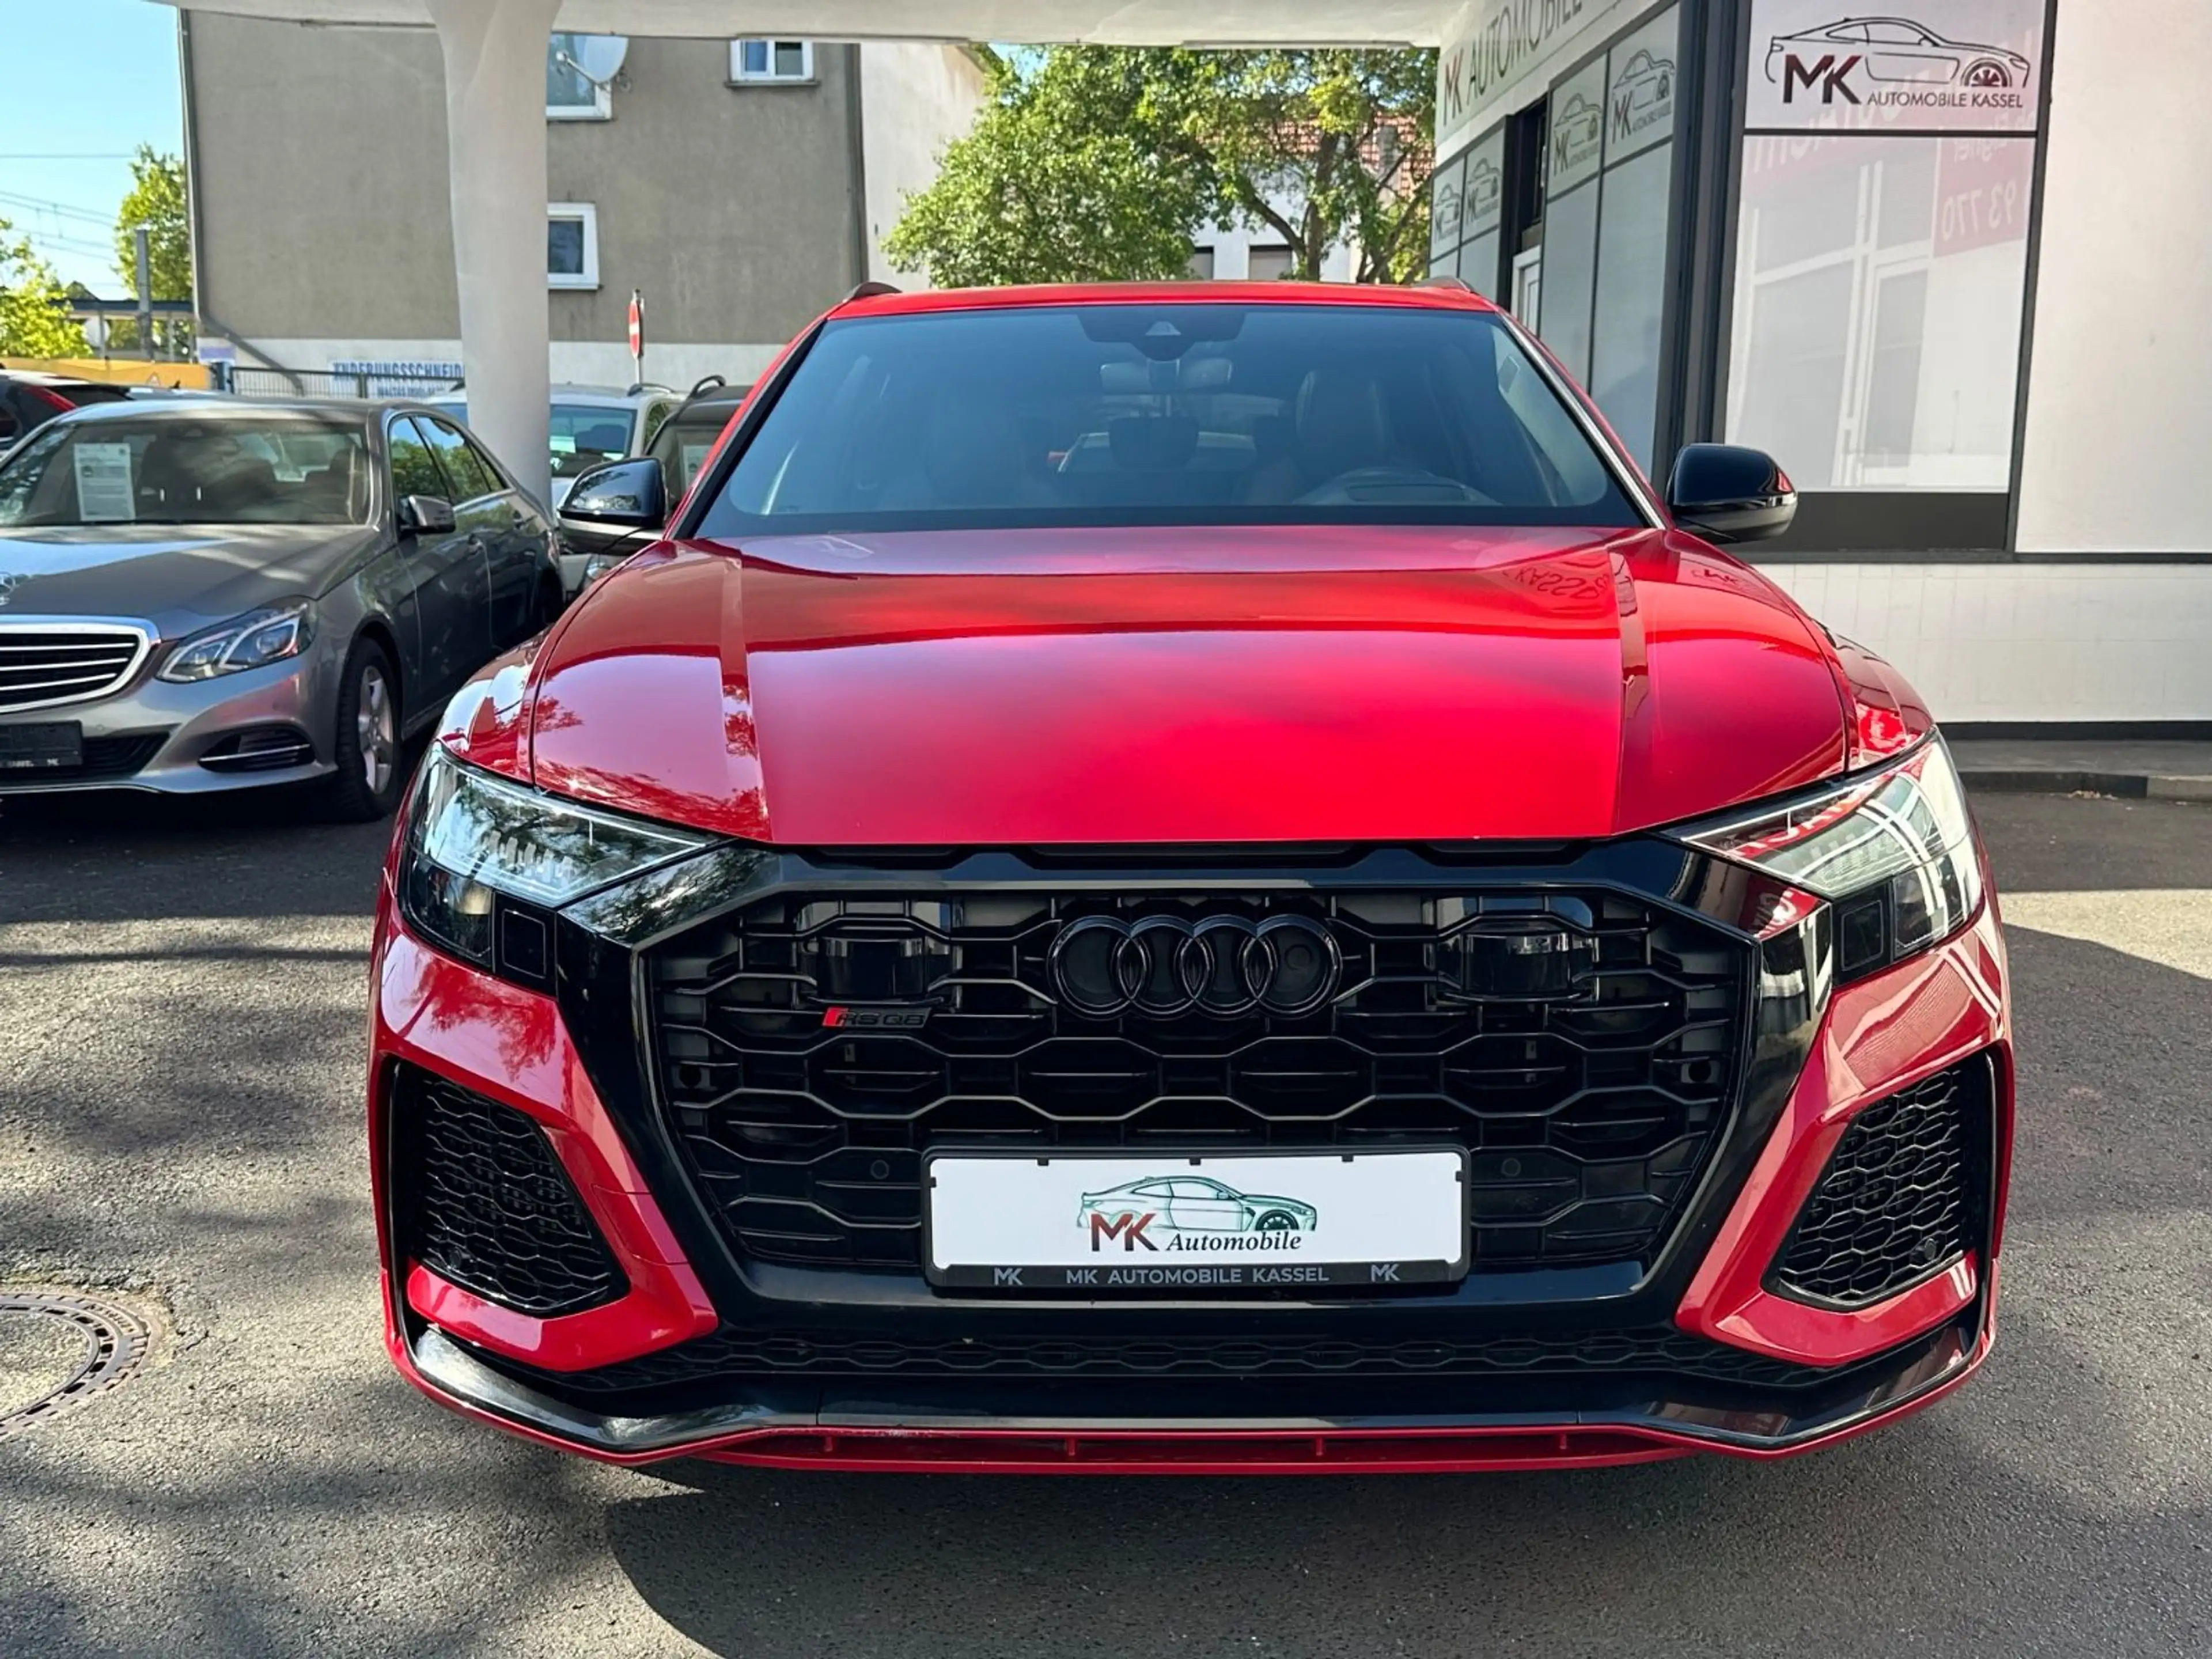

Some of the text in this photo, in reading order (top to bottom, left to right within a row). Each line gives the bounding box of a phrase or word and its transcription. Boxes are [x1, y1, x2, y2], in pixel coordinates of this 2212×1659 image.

[1442, 47, 1464, 127] MK
[1783, 54, 2024, 108] MK AUTOMOBILE KASSEL
[1612, 89, 1633, 144] MK
[1090, 1213, 1302, 1252] MK Automobile
[994, 1264, 1400, 1286] MK MK AUTOMOBILE KASSEL MK
